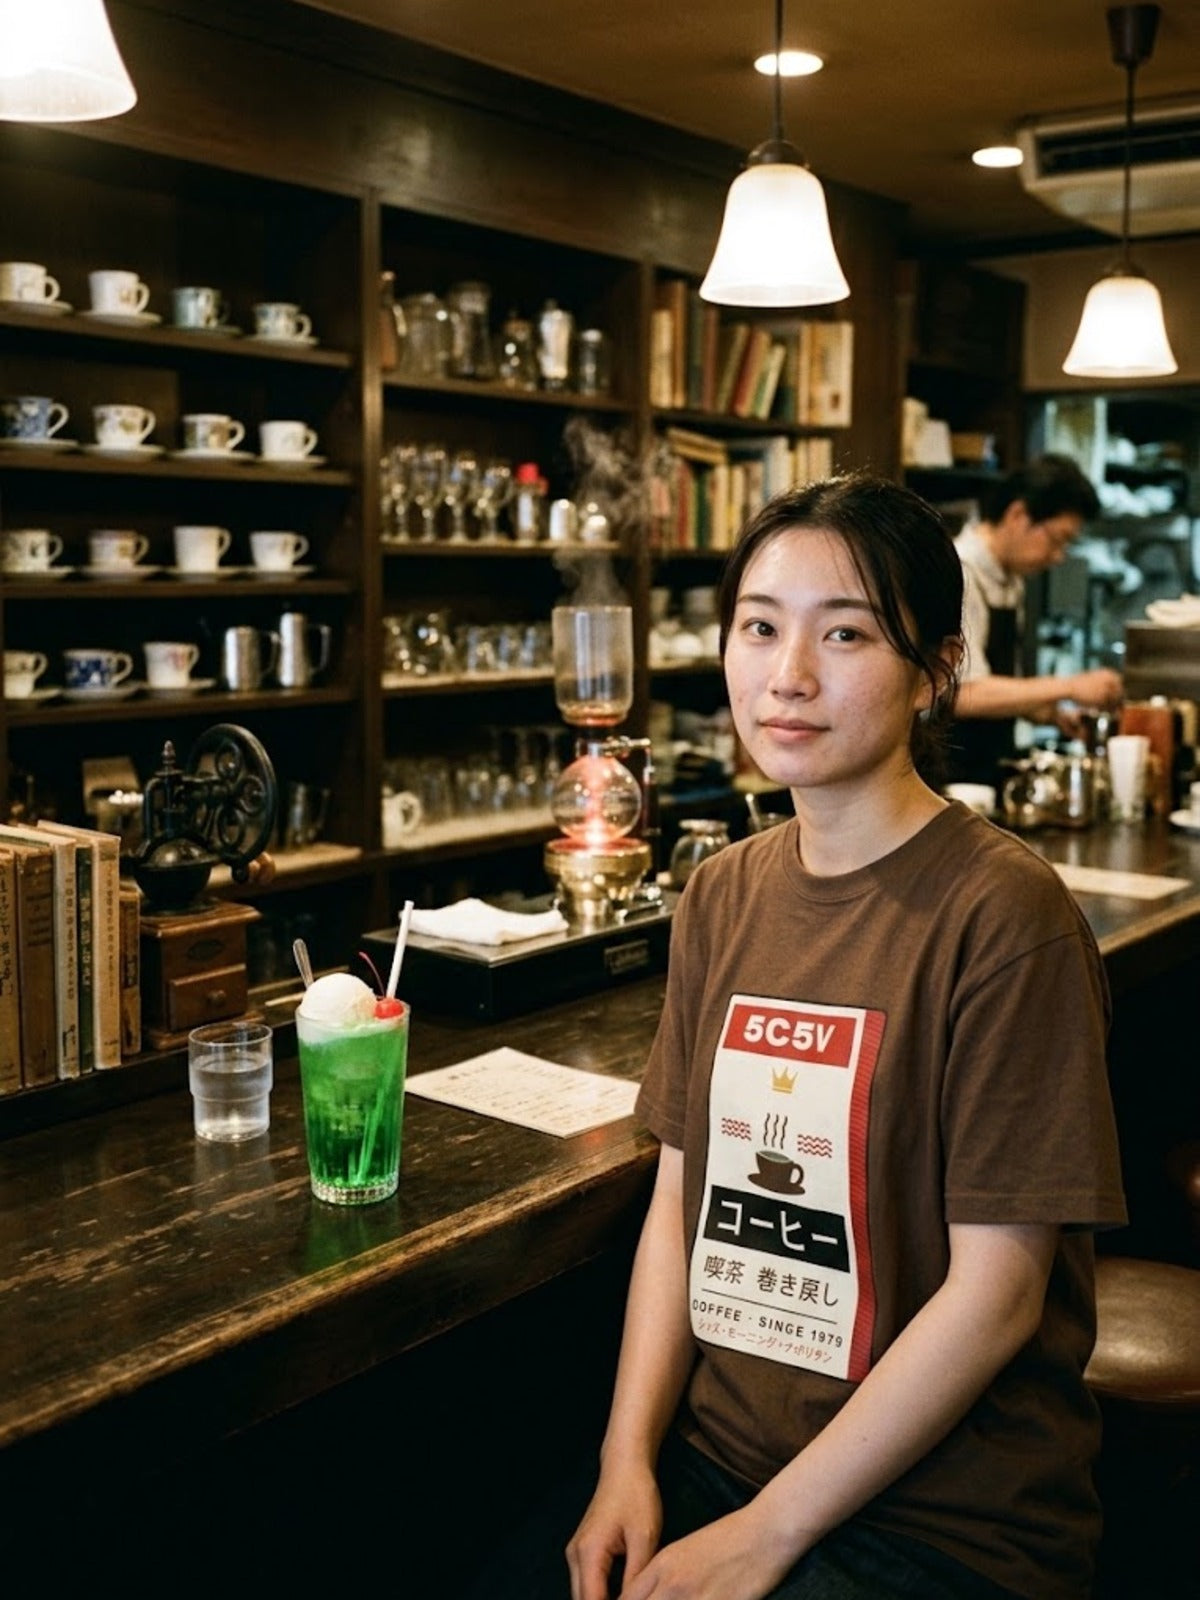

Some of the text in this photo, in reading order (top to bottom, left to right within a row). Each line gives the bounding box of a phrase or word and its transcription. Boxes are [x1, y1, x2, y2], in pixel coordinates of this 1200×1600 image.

[743, 1014, 836, 1053] 5C5V
[717, 1200, 839, 1252] コーヒー
[703, 1255, 839, 1307] 喫茶 巻き戻し
[811, 1329, 843, 1348] 1979
